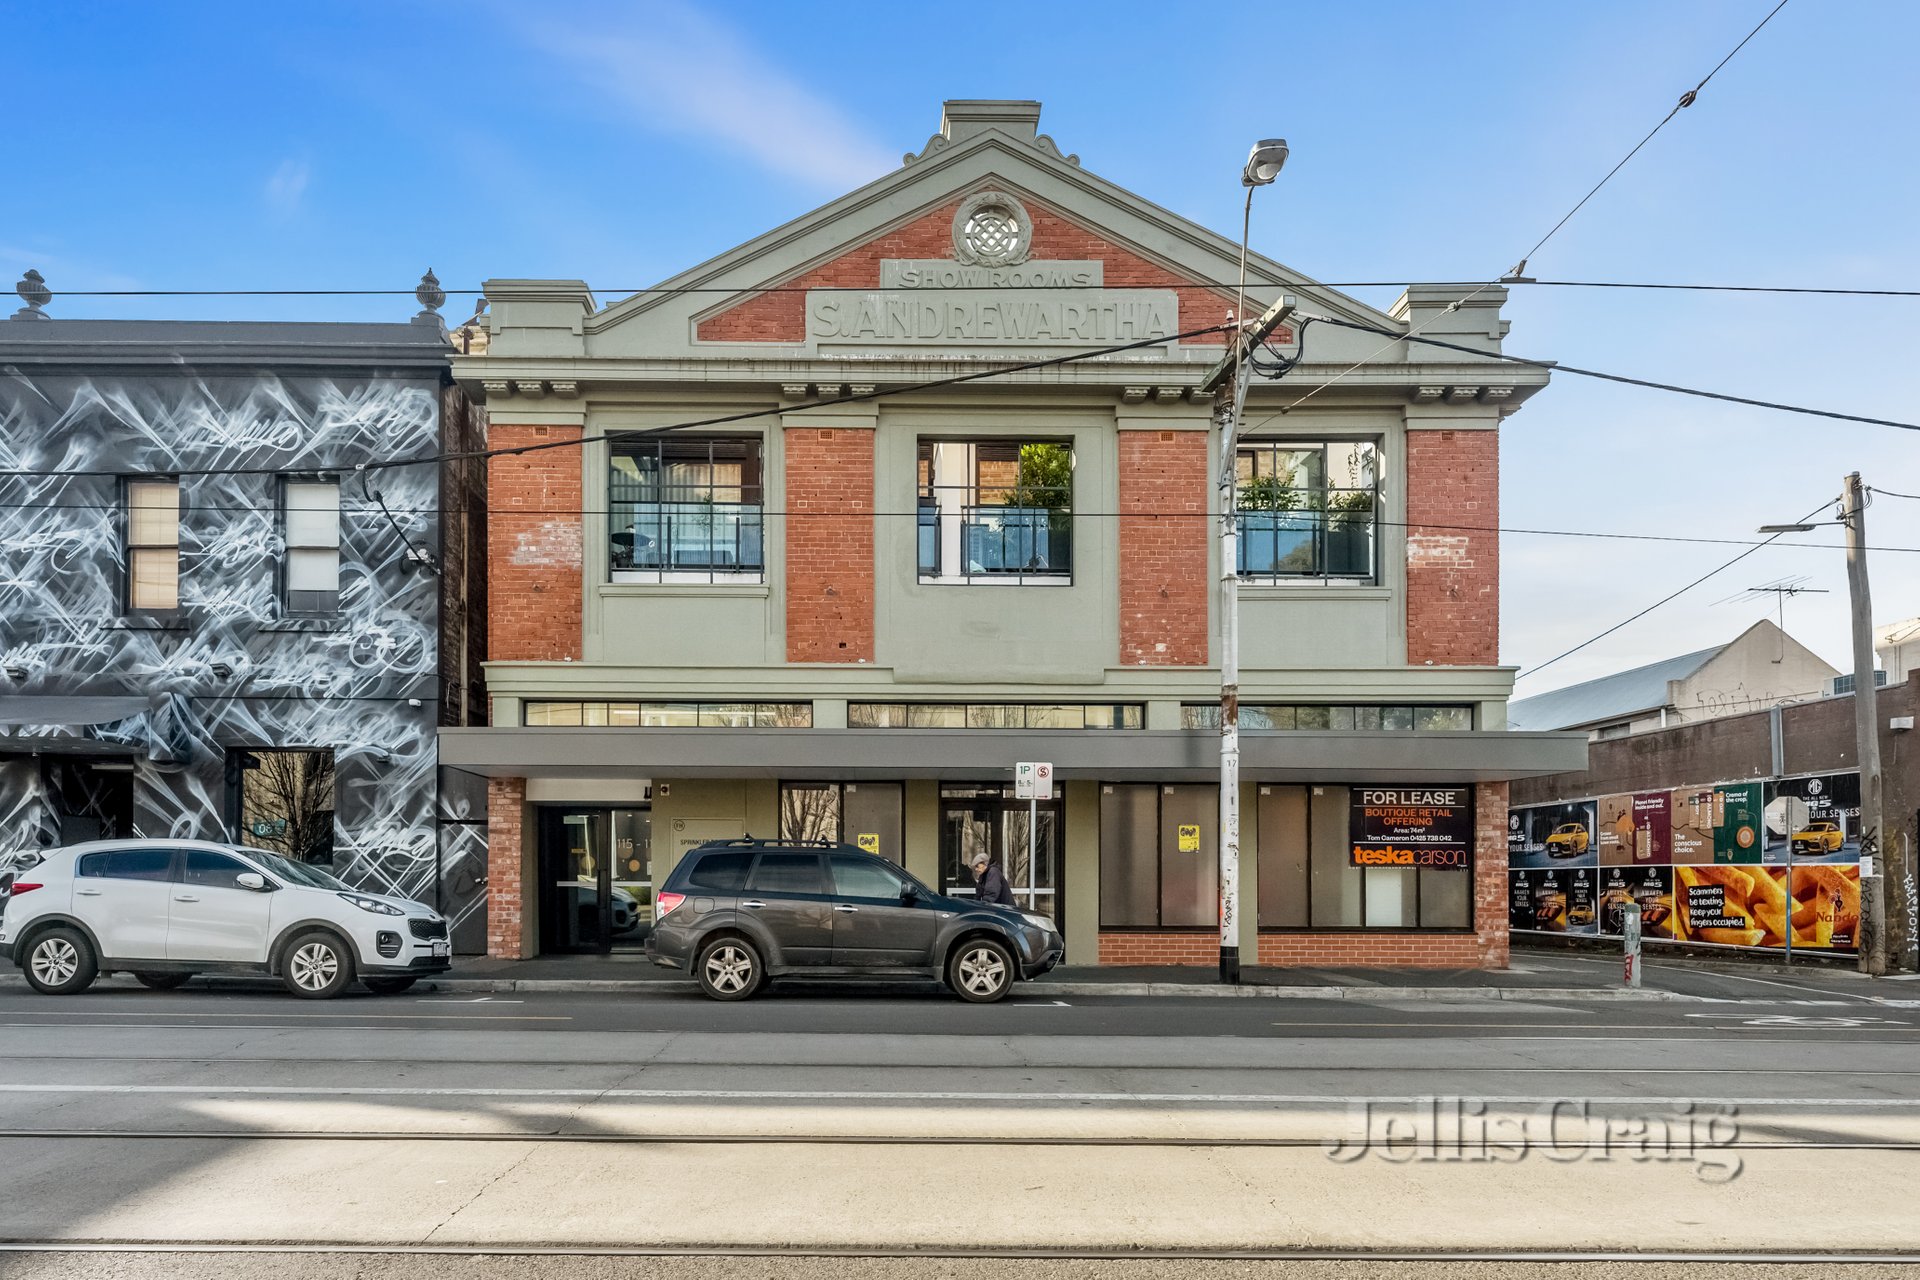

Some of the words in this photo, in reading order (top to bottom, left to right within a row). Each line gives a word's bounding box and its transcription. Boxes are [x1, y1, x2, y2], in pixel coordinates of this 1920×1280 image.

[1227, 760, 1236, 768] 17
[1020, 766, 1030, 774] 1P
[1808, 779, 1822, 794] MG
[1364, 792, 1396, 804] FOR
[1401, 792, 1455, 804] LEASE
[1365, 808, 1416, 817] BOUTIQUE
[1419, 809, 1452, 817] RETAIL
[617, 838, 632, 849] 115
[1354, 846, 1466, 864] teskacarson
[1699, 896, 1724, 906] texting.
[1707, 909, 1722, 917] your
[1816, 912, 1859, 922] Nando
[1690, 918, 1712, 927] fingers
[1713, 917, 1744, 927] occupied.
